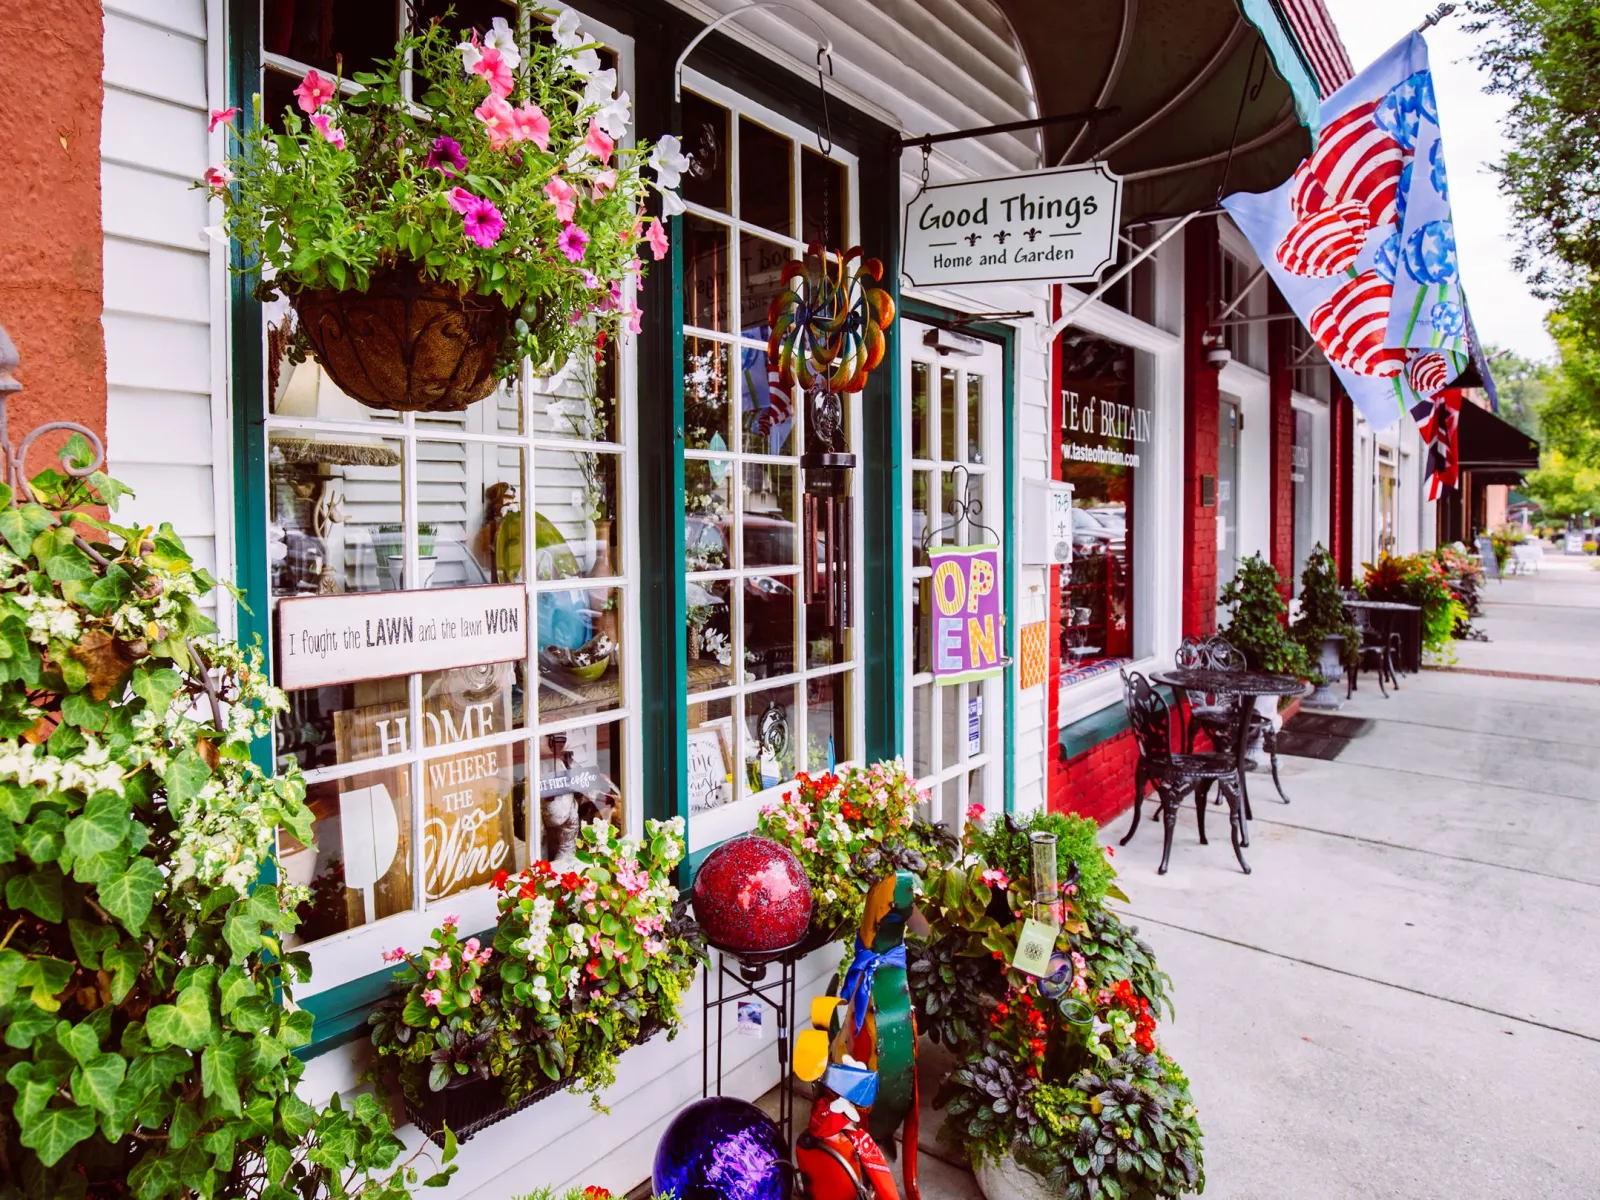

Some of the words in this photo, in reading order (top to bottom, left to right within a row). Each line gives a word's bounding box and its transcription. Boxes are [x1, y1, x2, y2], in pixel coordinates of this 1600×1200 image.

[919, 197, 988, 231] Good
[1000, 193, 1099, 229] Things
[933, 253, 973, 269] Home
[979, 249, 1007, 266] and
[1014, 245, 1075, 264] Garden
[1082, 396, 1096, 434] of
[1100, 400, 1151, 443] BRITAIN
[289, 633, 296, 656] I
[302, 629, 338, 659] fought
[343, 626, 361, 649] the
[366, 616, 413, 648] LAWN
[418, 618, 437, 642] and
[441, 617, 457, 639] the
[460, 616, 482, 638] lawn
[485, 607, 518, 635] WON
[430, 752, 499, 790] WHERE
[570, 771, 597, 788] coffee
[443, 788, 473, 813] THE
[405, 798, 510, 900] Wine
